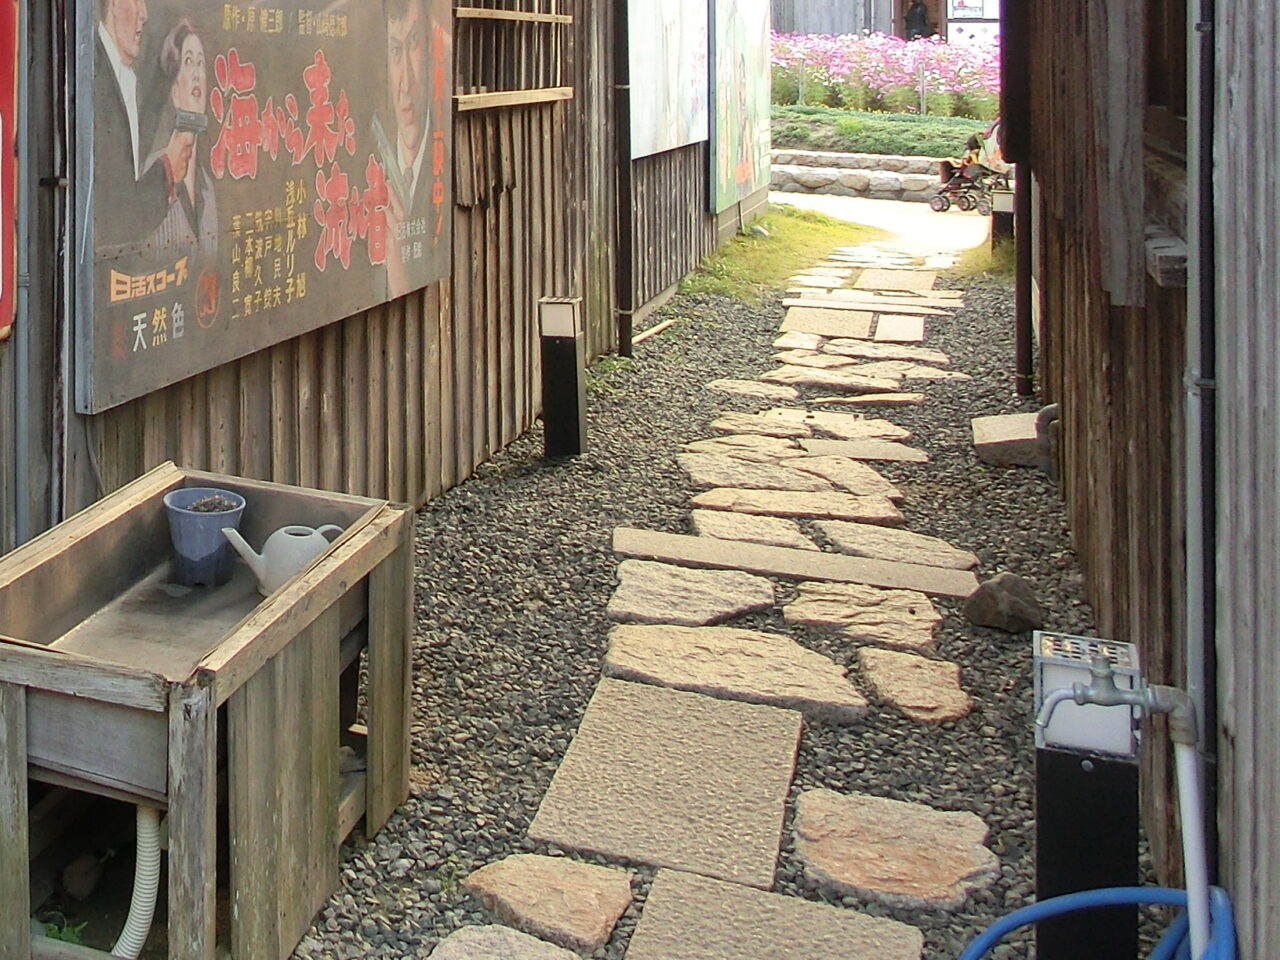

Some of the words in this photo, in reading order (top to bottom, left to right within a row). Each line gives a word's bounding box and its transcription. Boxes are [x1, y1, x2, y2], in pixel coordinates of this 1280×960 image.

[210, 47, 357, 180] 海から来た
[109, 256, 189, 303] 日活スコープ
